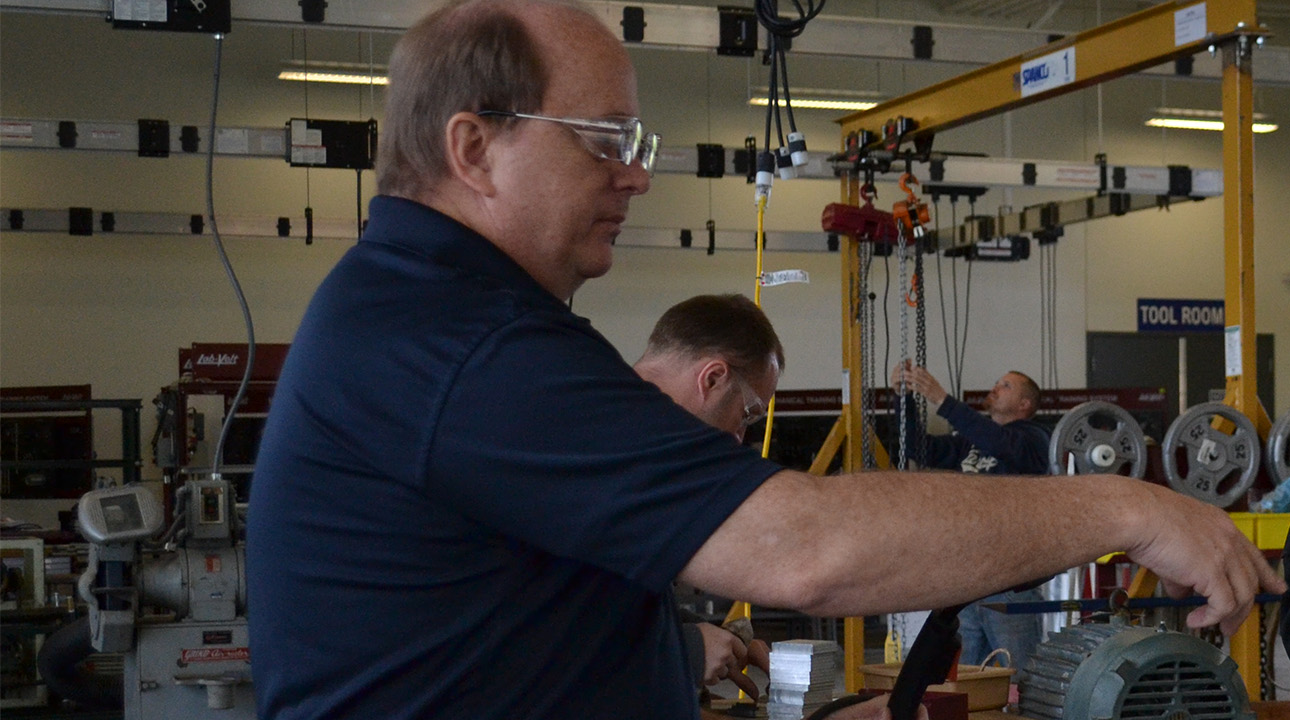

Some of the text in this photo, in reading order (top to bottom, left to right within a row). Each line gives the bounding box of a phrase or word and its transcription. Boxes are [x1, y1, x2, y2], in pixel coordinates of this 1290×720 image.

[1063, 51, 1069, 75] 1
[1140, 305, 1224, 325] TOOL ROOM
[1195, 478, 1211, 492] 25
